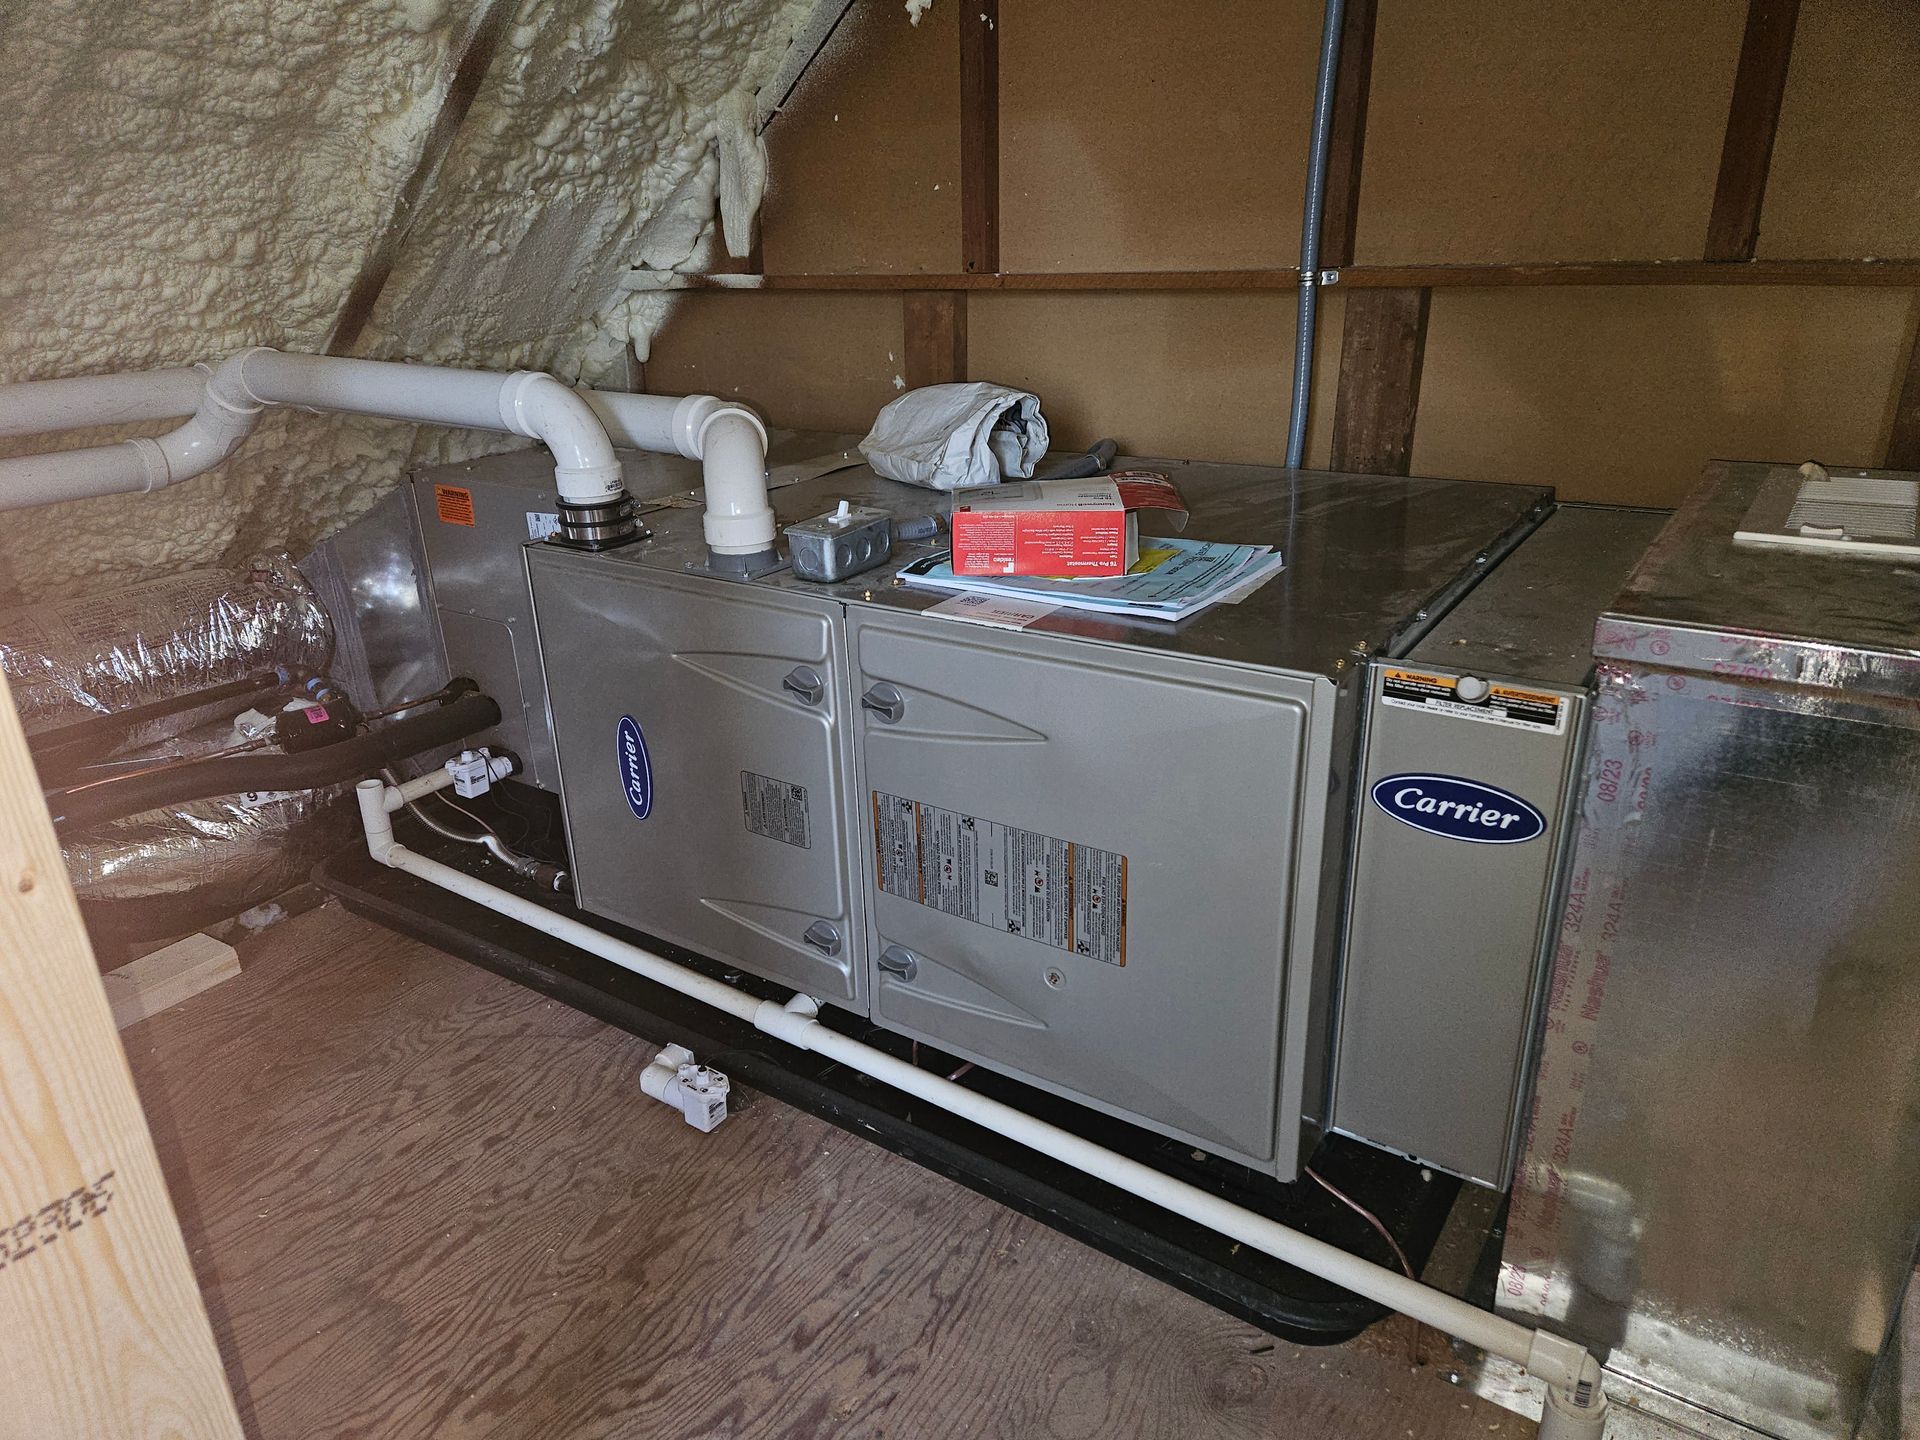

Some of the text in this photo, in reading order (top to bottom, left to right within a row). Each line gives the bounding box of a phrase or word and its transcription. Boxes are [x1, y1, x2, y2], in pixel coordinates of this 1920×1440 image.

[1405, 673, 1436, 683] WARNING
[618, 730, 642, 806] Carrier
[1598, 759, 1623, 802] 08/23
[1394, 788, 1520, 829] Carrier
[1564, 892, 1586, 931] 324A
[1552, 1127, 1574, 1162] 324A
